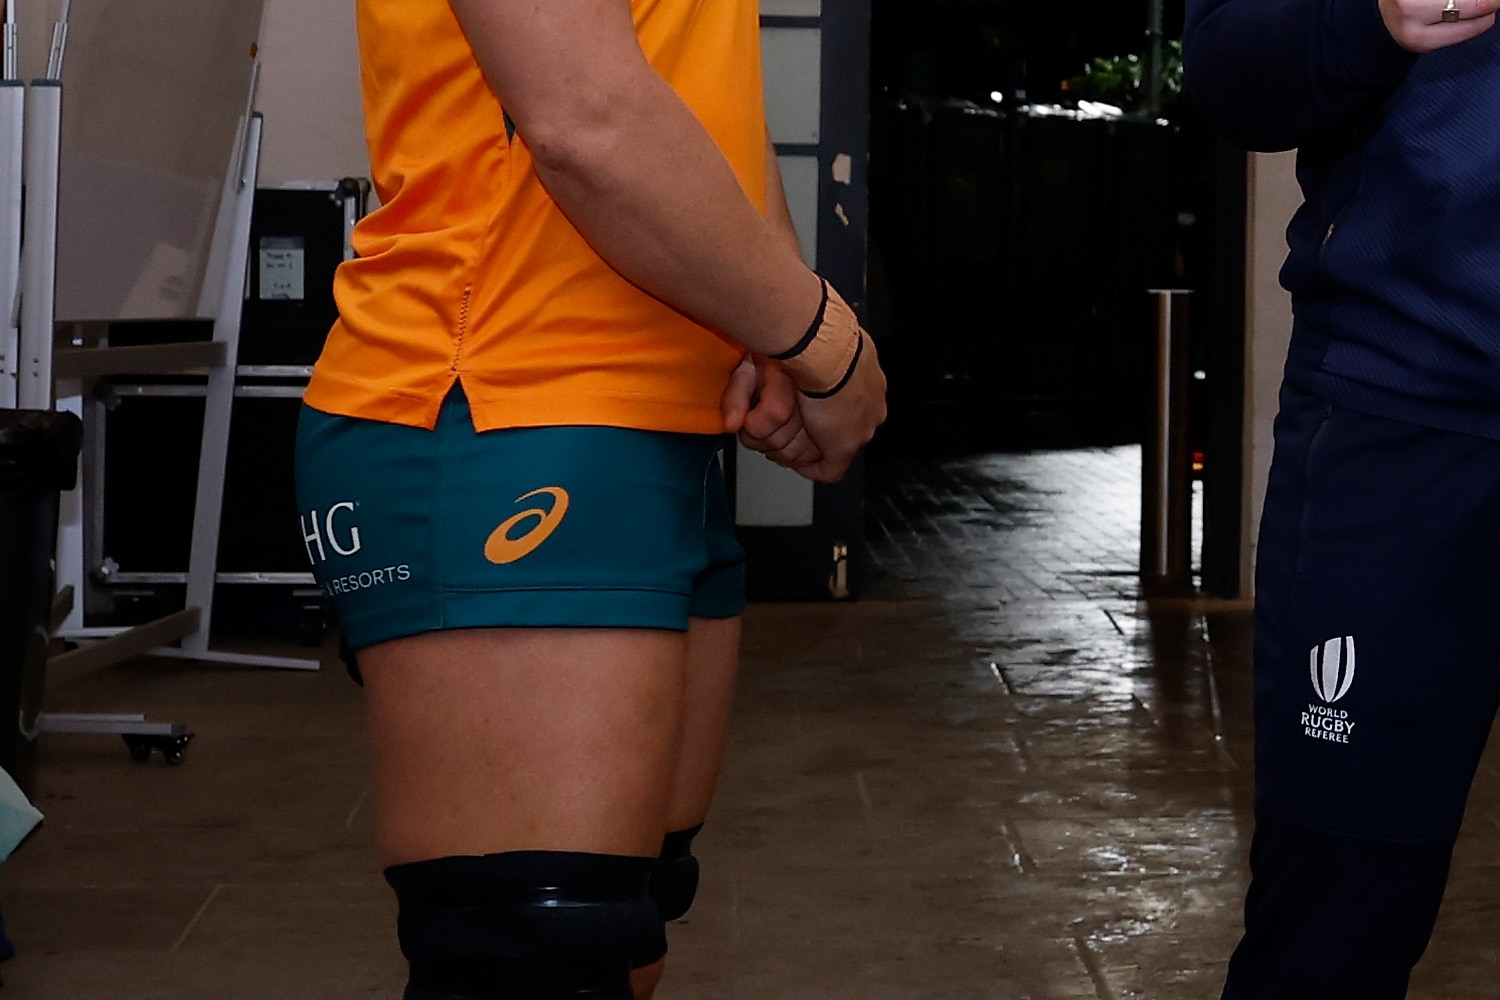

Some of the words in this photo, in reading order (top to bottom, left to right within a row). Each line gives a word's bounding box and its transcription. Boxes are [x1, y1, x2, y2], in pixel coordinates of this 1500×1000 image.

[332, 564, 411, 595] RESORTS
[1308, 703, 1349, 719] WORLD
[1301, 711, 1356, 735] RUGBY
[1304, 726, 1350, 744] REFEREE
